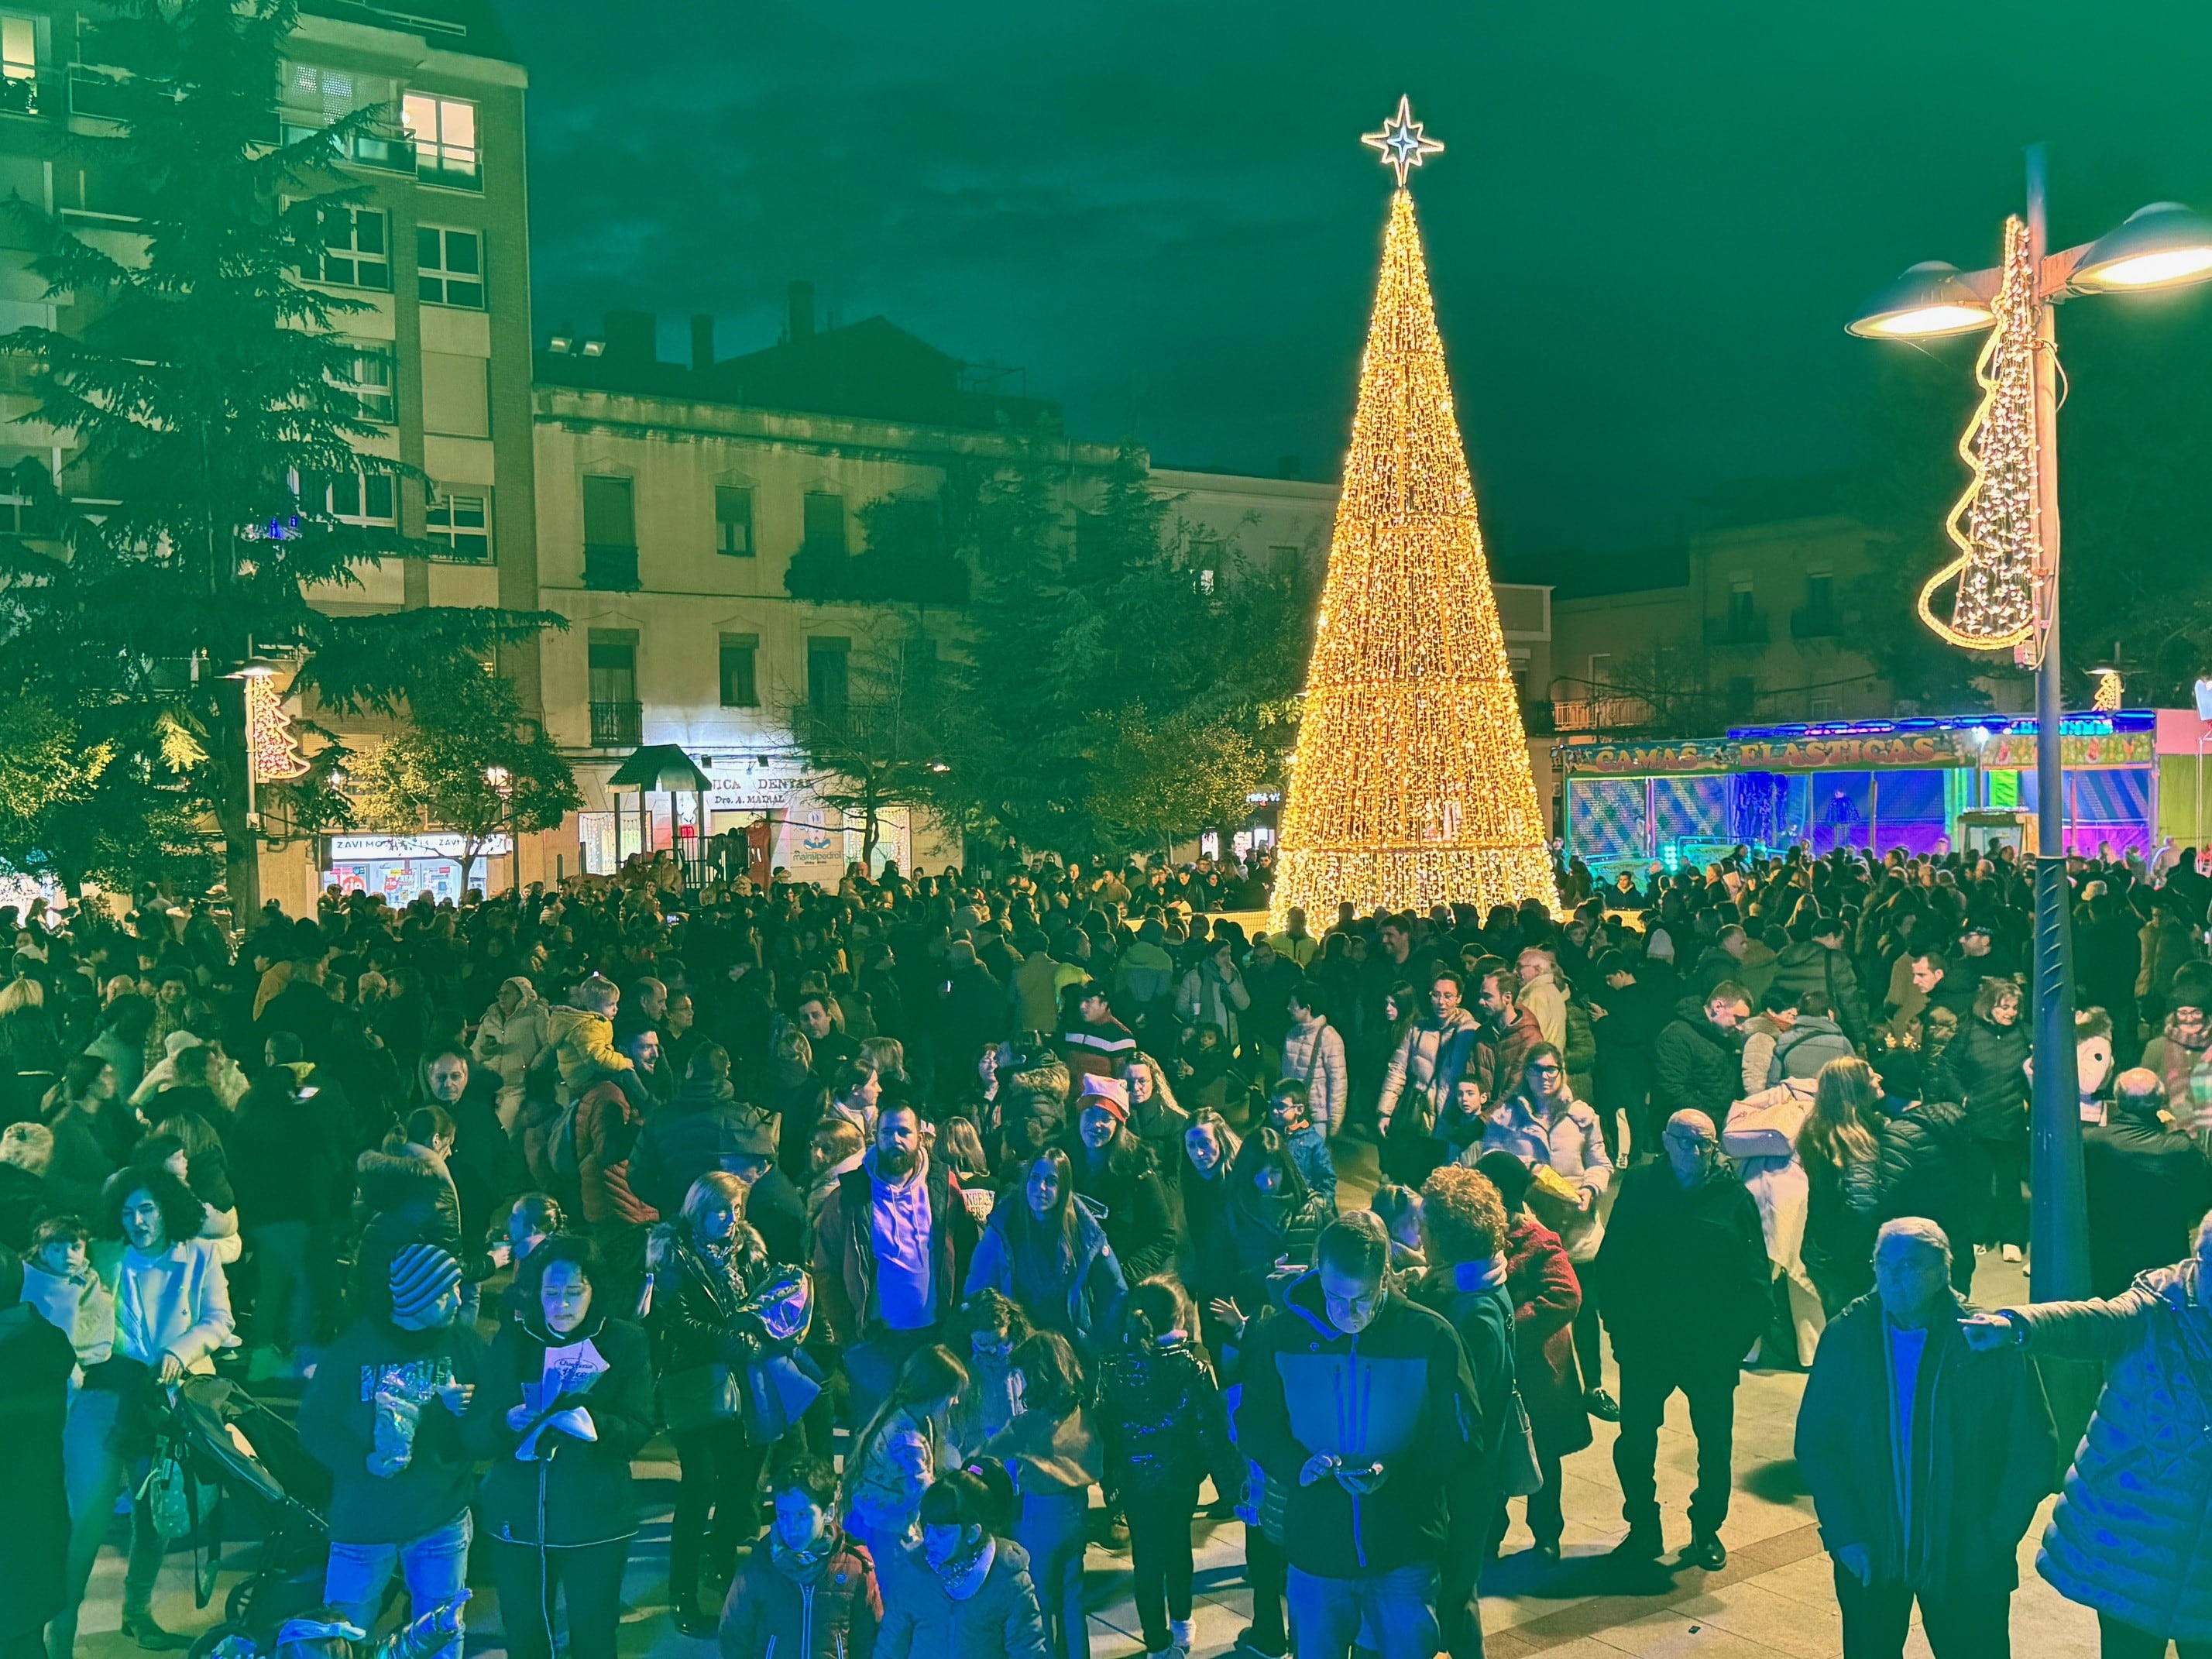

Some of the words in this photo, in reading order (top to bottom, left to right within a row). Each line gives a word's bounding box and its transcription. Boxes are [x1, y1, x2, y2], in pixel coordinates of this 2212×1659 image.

[1596, 747, 1698, 771] CAMAS
[1740, 737, 1935, 767] ELASTICAS
[747, 795, 785, 803] MAIRAL
